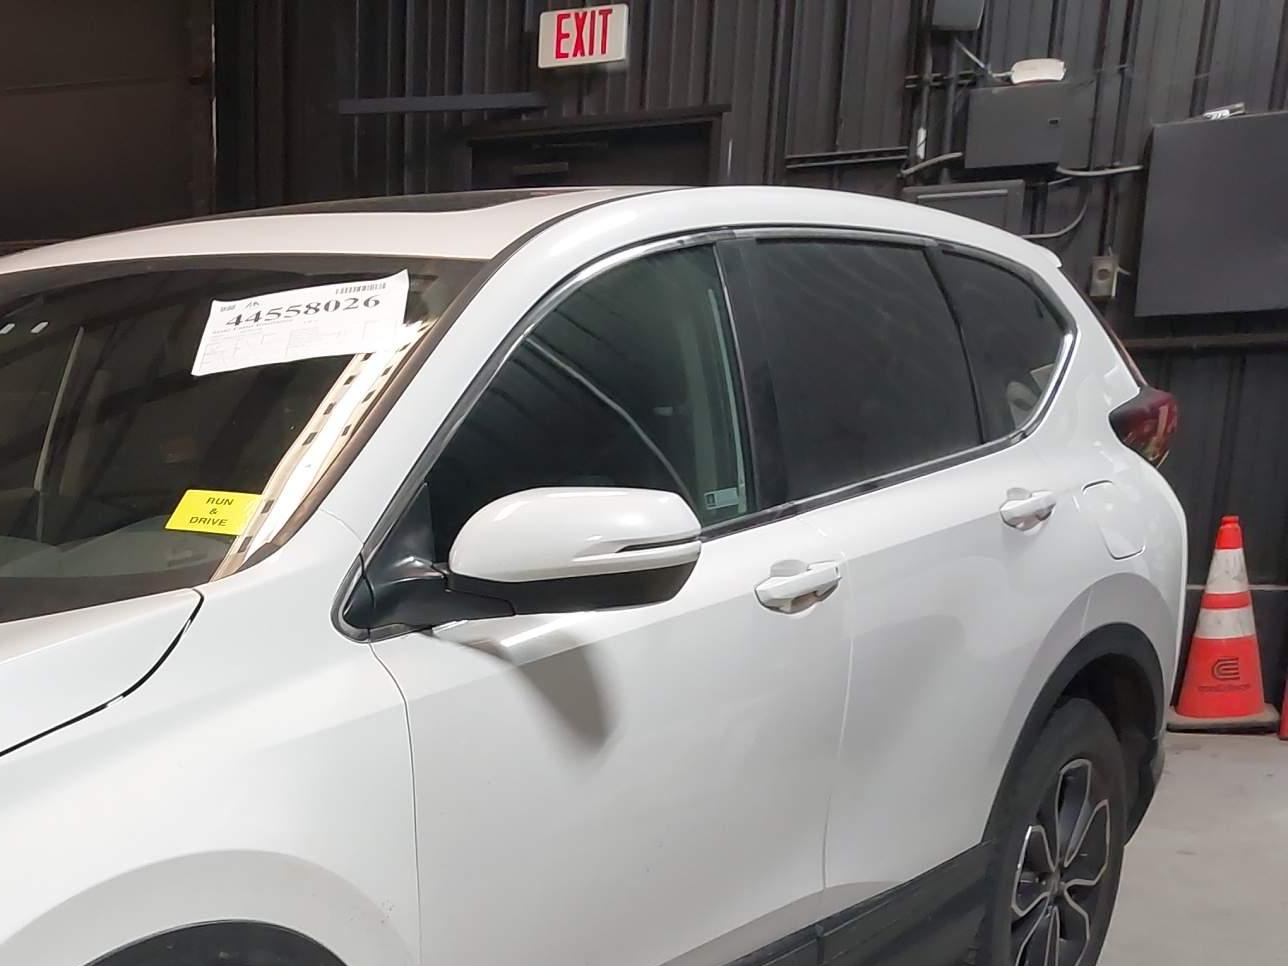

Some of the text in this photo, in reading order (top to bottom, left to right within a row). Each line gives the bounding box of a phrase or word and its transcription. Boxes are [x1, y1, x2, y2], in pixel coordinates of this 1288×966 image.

[555, 8, 613, 59] EXIT
[225, 295, 381, 326] 44558026
[206, 496, 234, 506] RUN
[209, 507, 217, 515] &
[189, 516, 228, 526] DRIVE
